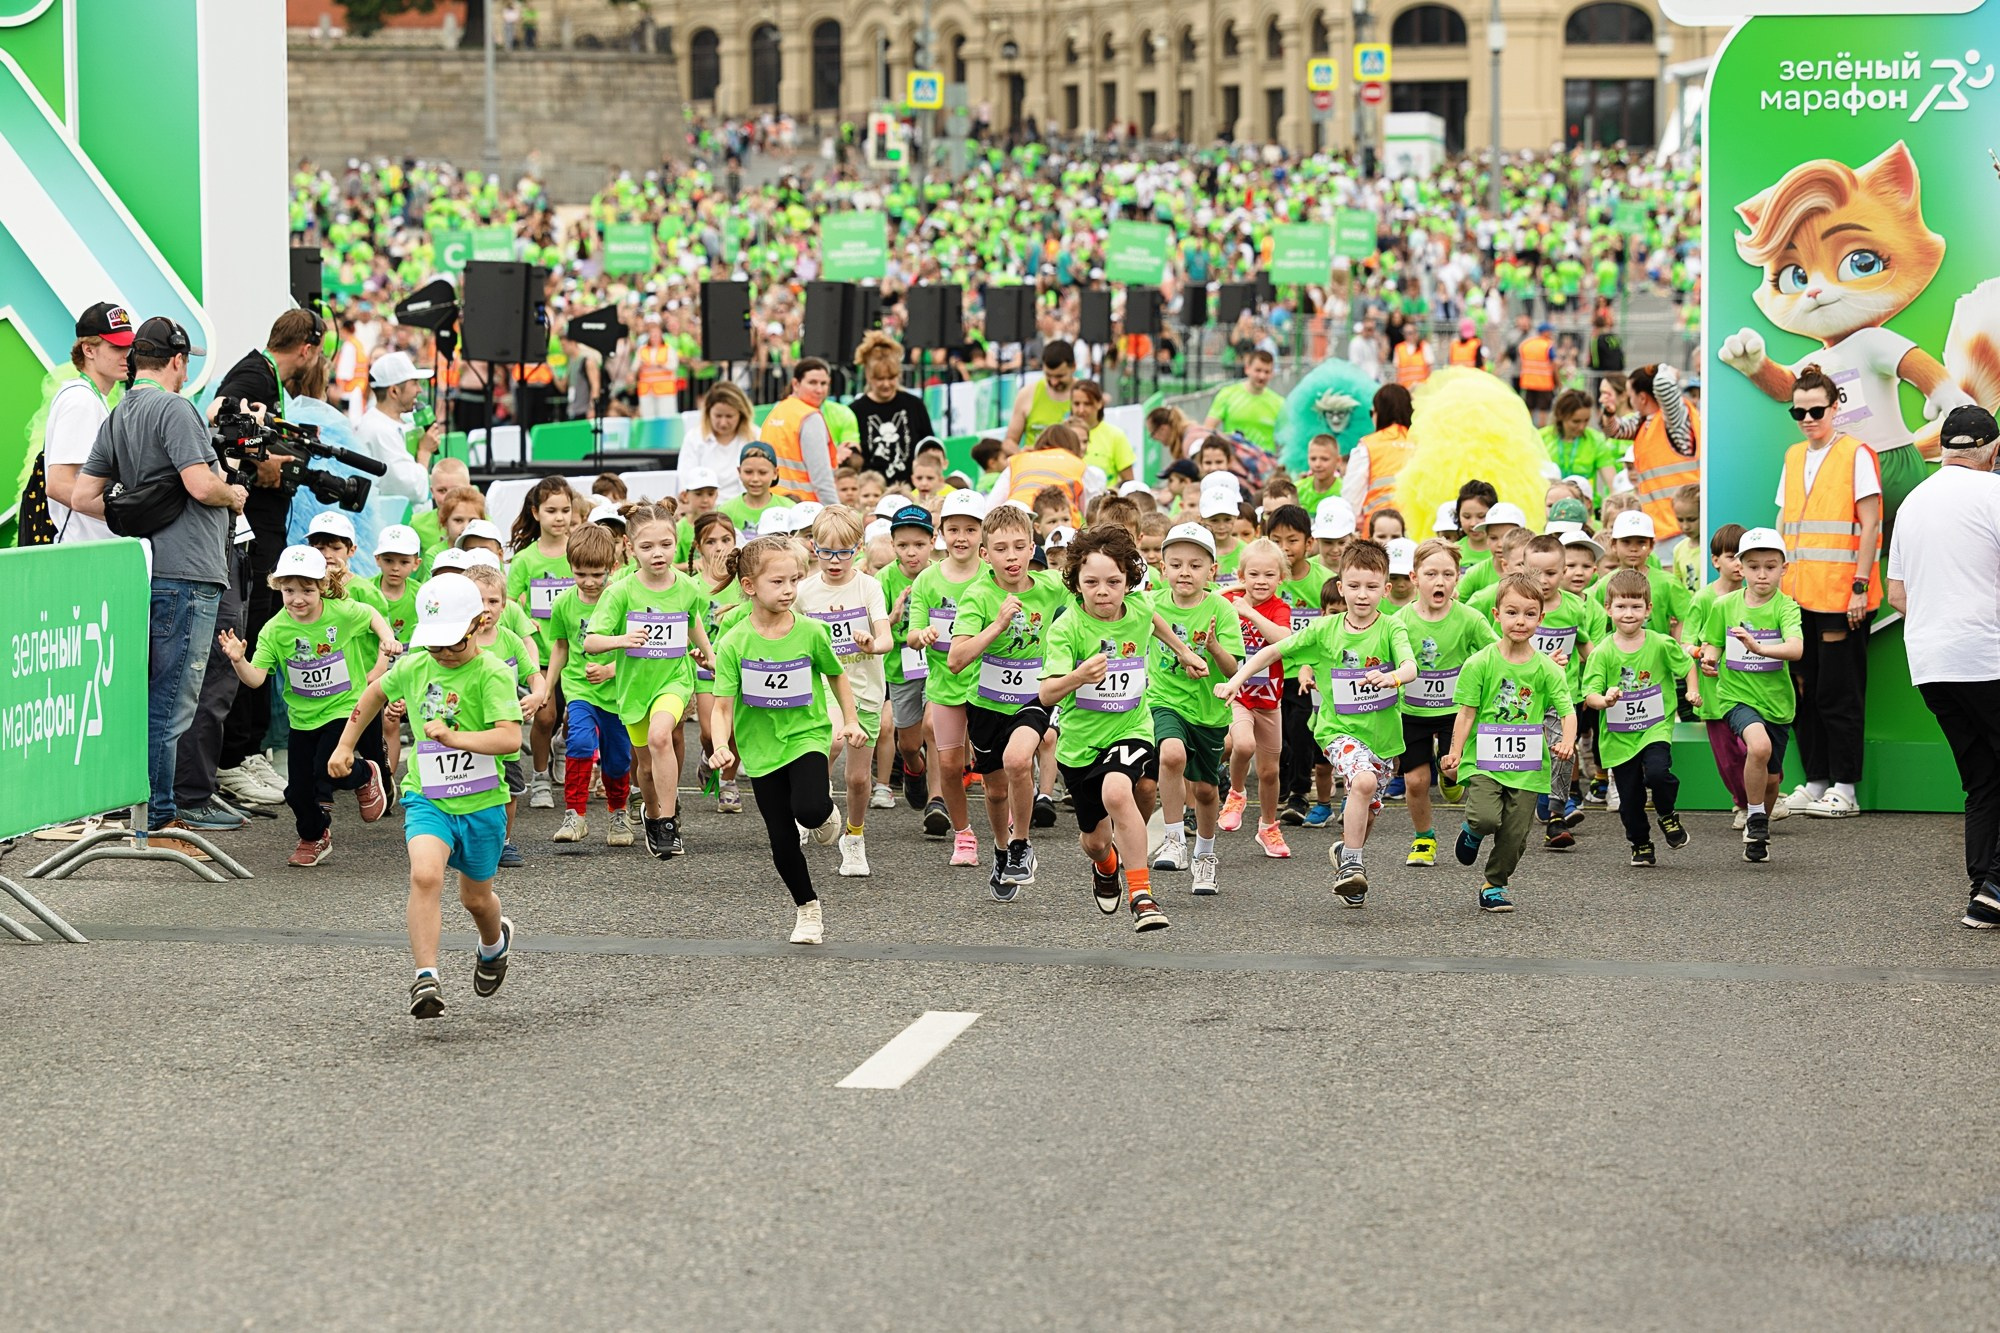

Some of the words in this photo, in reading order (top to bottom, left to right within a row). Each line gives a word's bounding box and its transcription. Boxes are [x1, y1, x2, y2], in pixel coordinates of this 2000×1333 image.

[1778, 50, 1921, 82] зелёный
[1760, 81, 1908, 117] марафон
[643, 624, 672, 640] 221
[11, 605, 82, 679] зелёный
[1537, 637, 1565, 651] 167
[301, 666, 331, 684] 207
[764, 673, 789, 689] 42
[1001, 669, 1023, 686] 36
[1095, 672, 1130, 691] 219
[1424, 679, 1445, 693] 70
[1353, 693, 1379, 702] АРСЕНИЙ
[1626, 700, 1646, 716] 54
[2, 677, 75, 760] марафон
[1494, 736, 1526, 753] 115
[435, 751, 475, 774] 172
[445, 773, 468, 781] РОМАН
